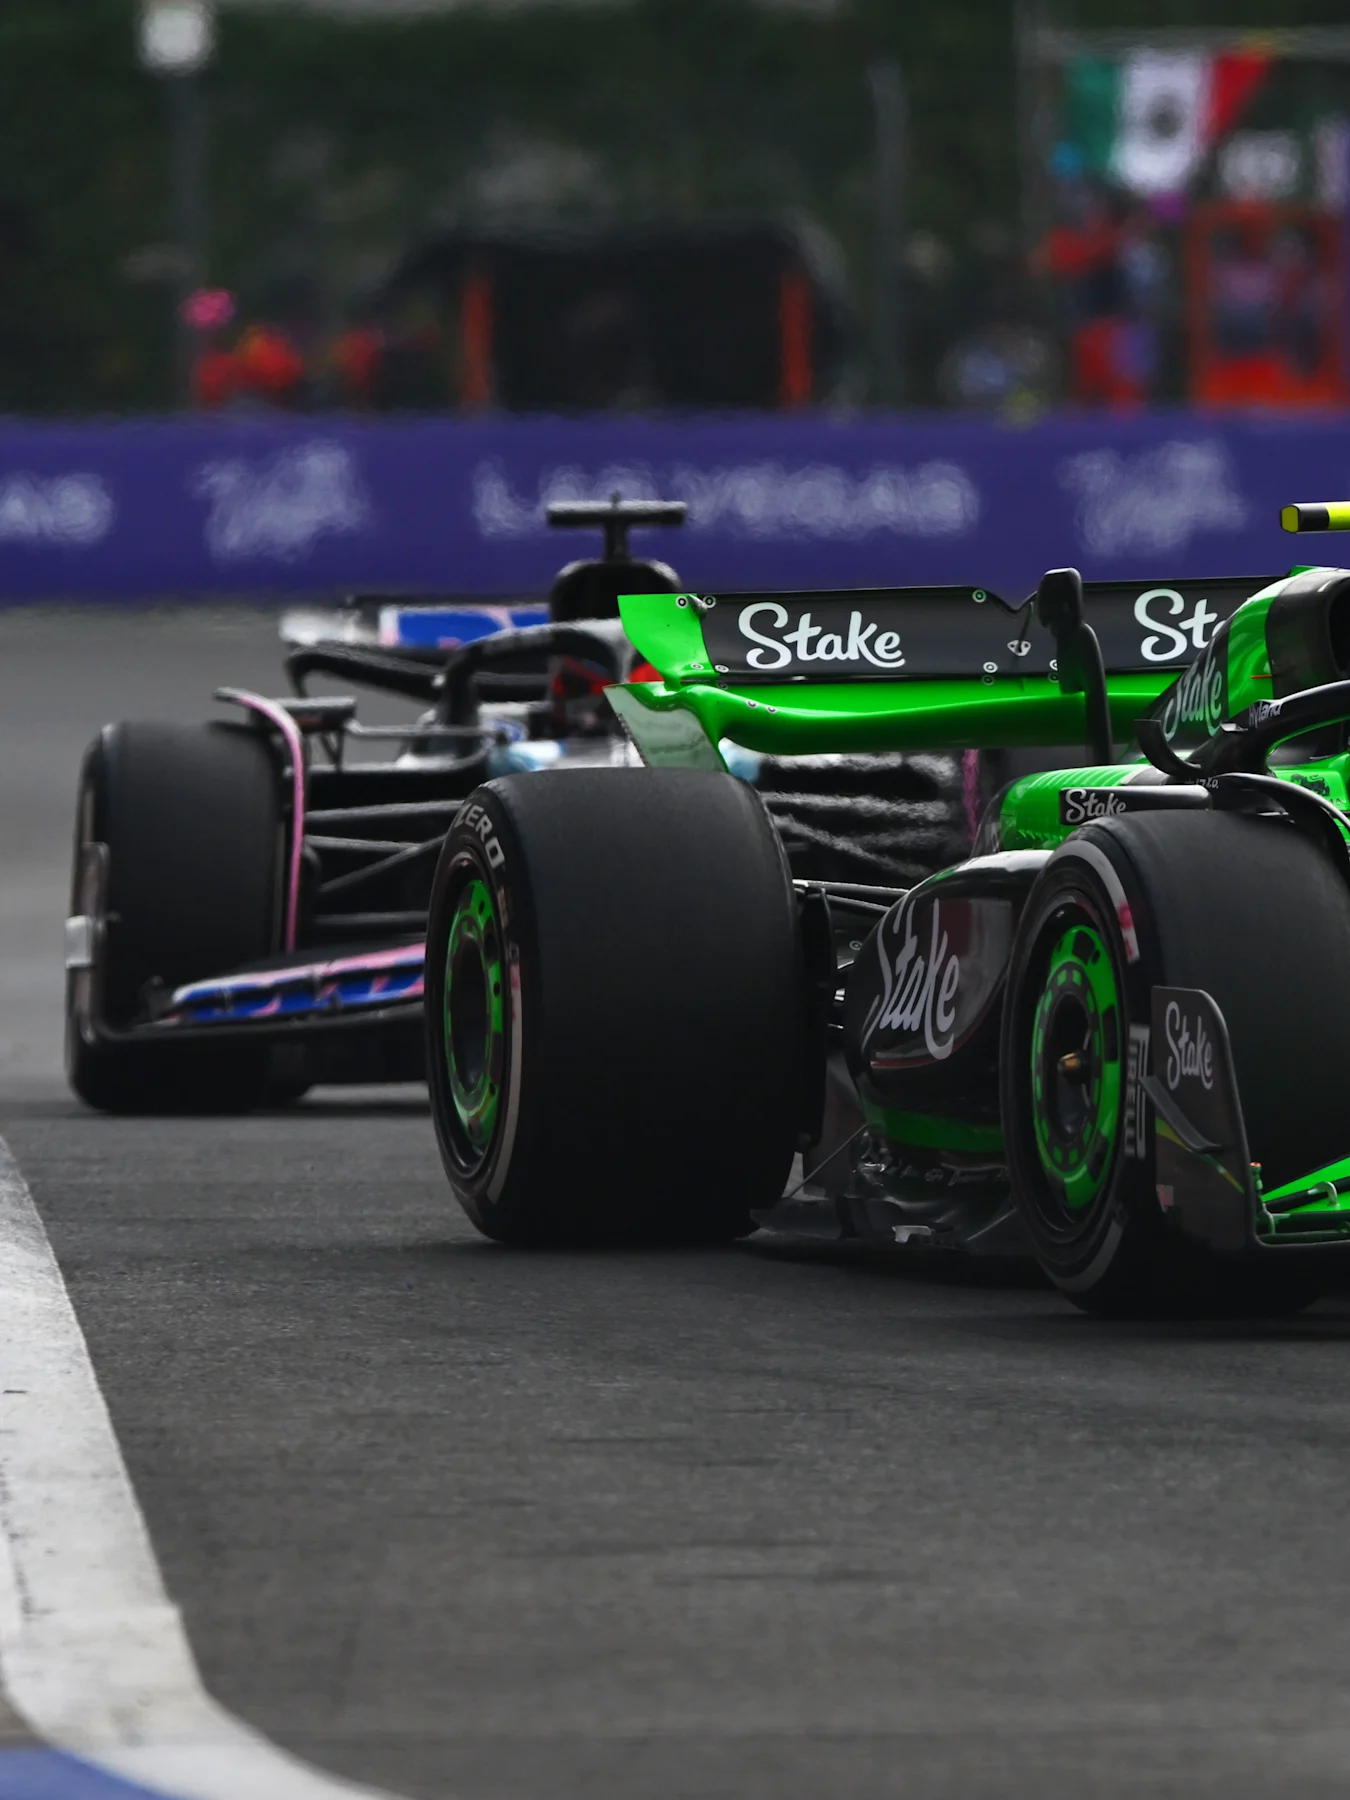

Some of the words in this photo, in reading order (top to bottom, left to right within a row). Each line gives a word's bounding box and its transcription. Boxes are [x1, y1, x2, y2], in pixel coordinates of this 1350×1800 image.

[739, 602, 905, 669] Stake
[453, 803, 504, 869] ZERO
[1065, 789, 1127, 824] Stake
[861, 900, 960, 1059] Stake
[1166, 1001, 1213, 1089] Stake
